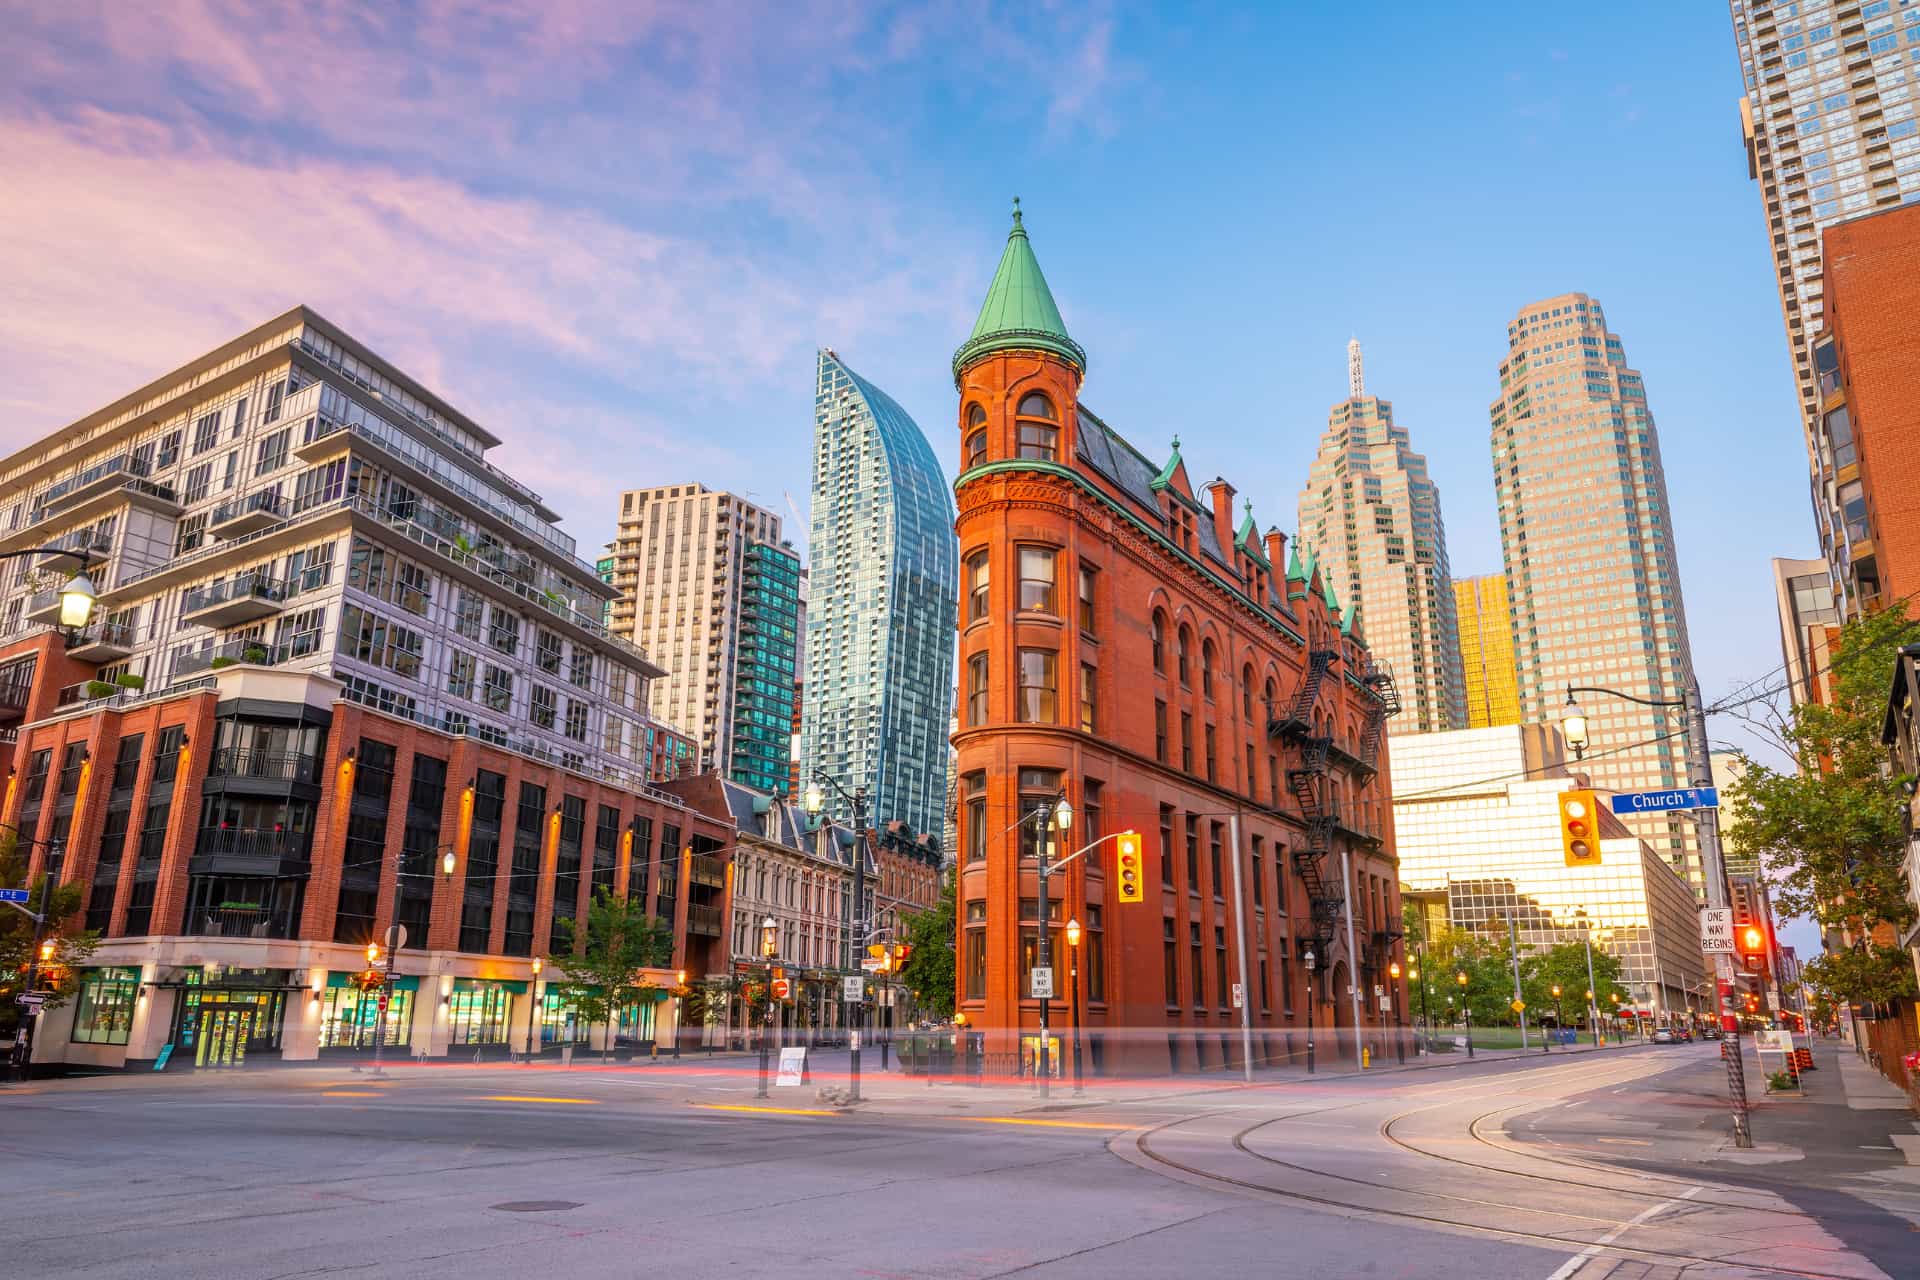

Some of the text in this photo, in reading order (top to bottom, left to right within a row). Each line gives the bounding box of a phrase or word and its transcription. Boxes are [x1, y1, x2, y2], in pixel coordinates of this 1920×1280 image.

[1632, 792, 1683, 808] Church
[1707, 911, 1724, 921] ONE
[1707, 925, 1724, 935] WAY
[1702, 938, 1733, 949] BEGINS
